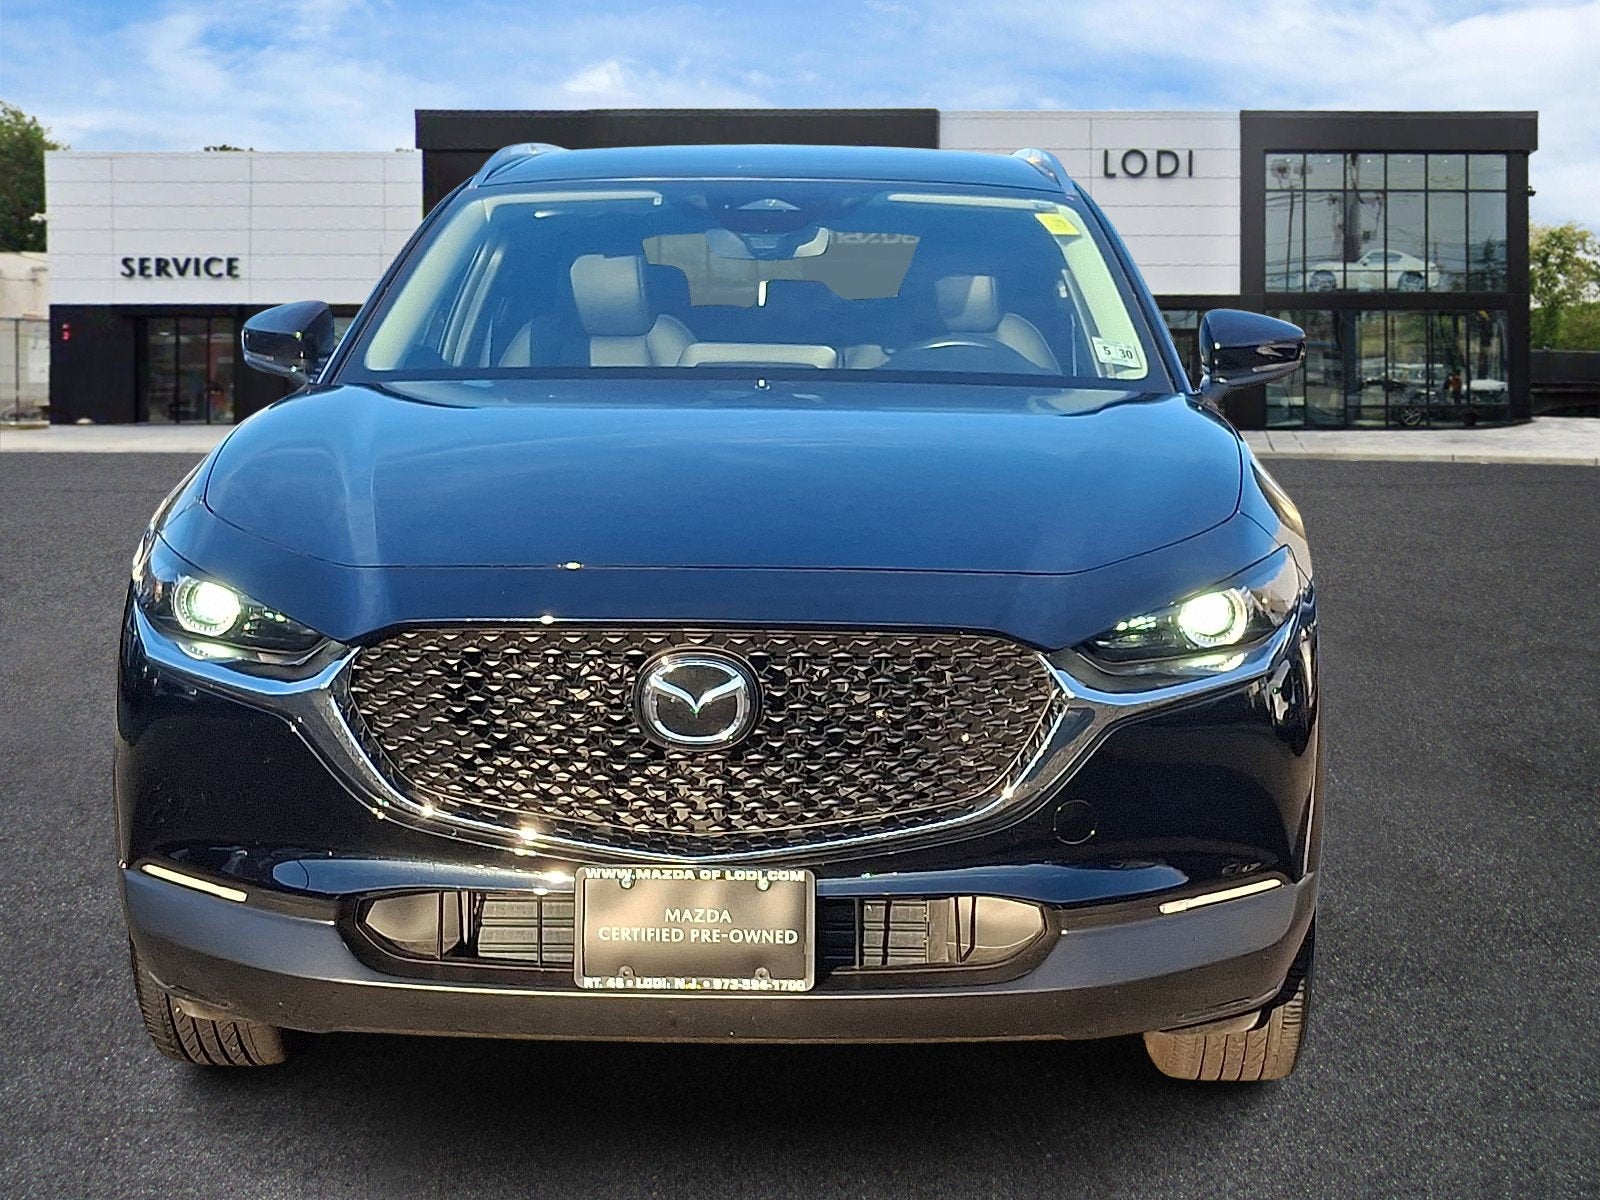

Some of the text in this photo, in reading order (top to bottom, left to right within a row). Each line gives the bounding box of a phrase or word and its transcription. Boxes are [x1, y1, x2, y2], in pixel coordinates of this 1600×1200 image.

[1103, 149, 1193, 178] LODI
[120, 257, 240, 278] SERVICE
[1103, 346, 1133, 360] 5 30
[700, 869, 721, 881] OF
[664, 908, 732, 923] MAZDA
[598, 926, 799, 945] CERTIFIED PRE-OWNED
